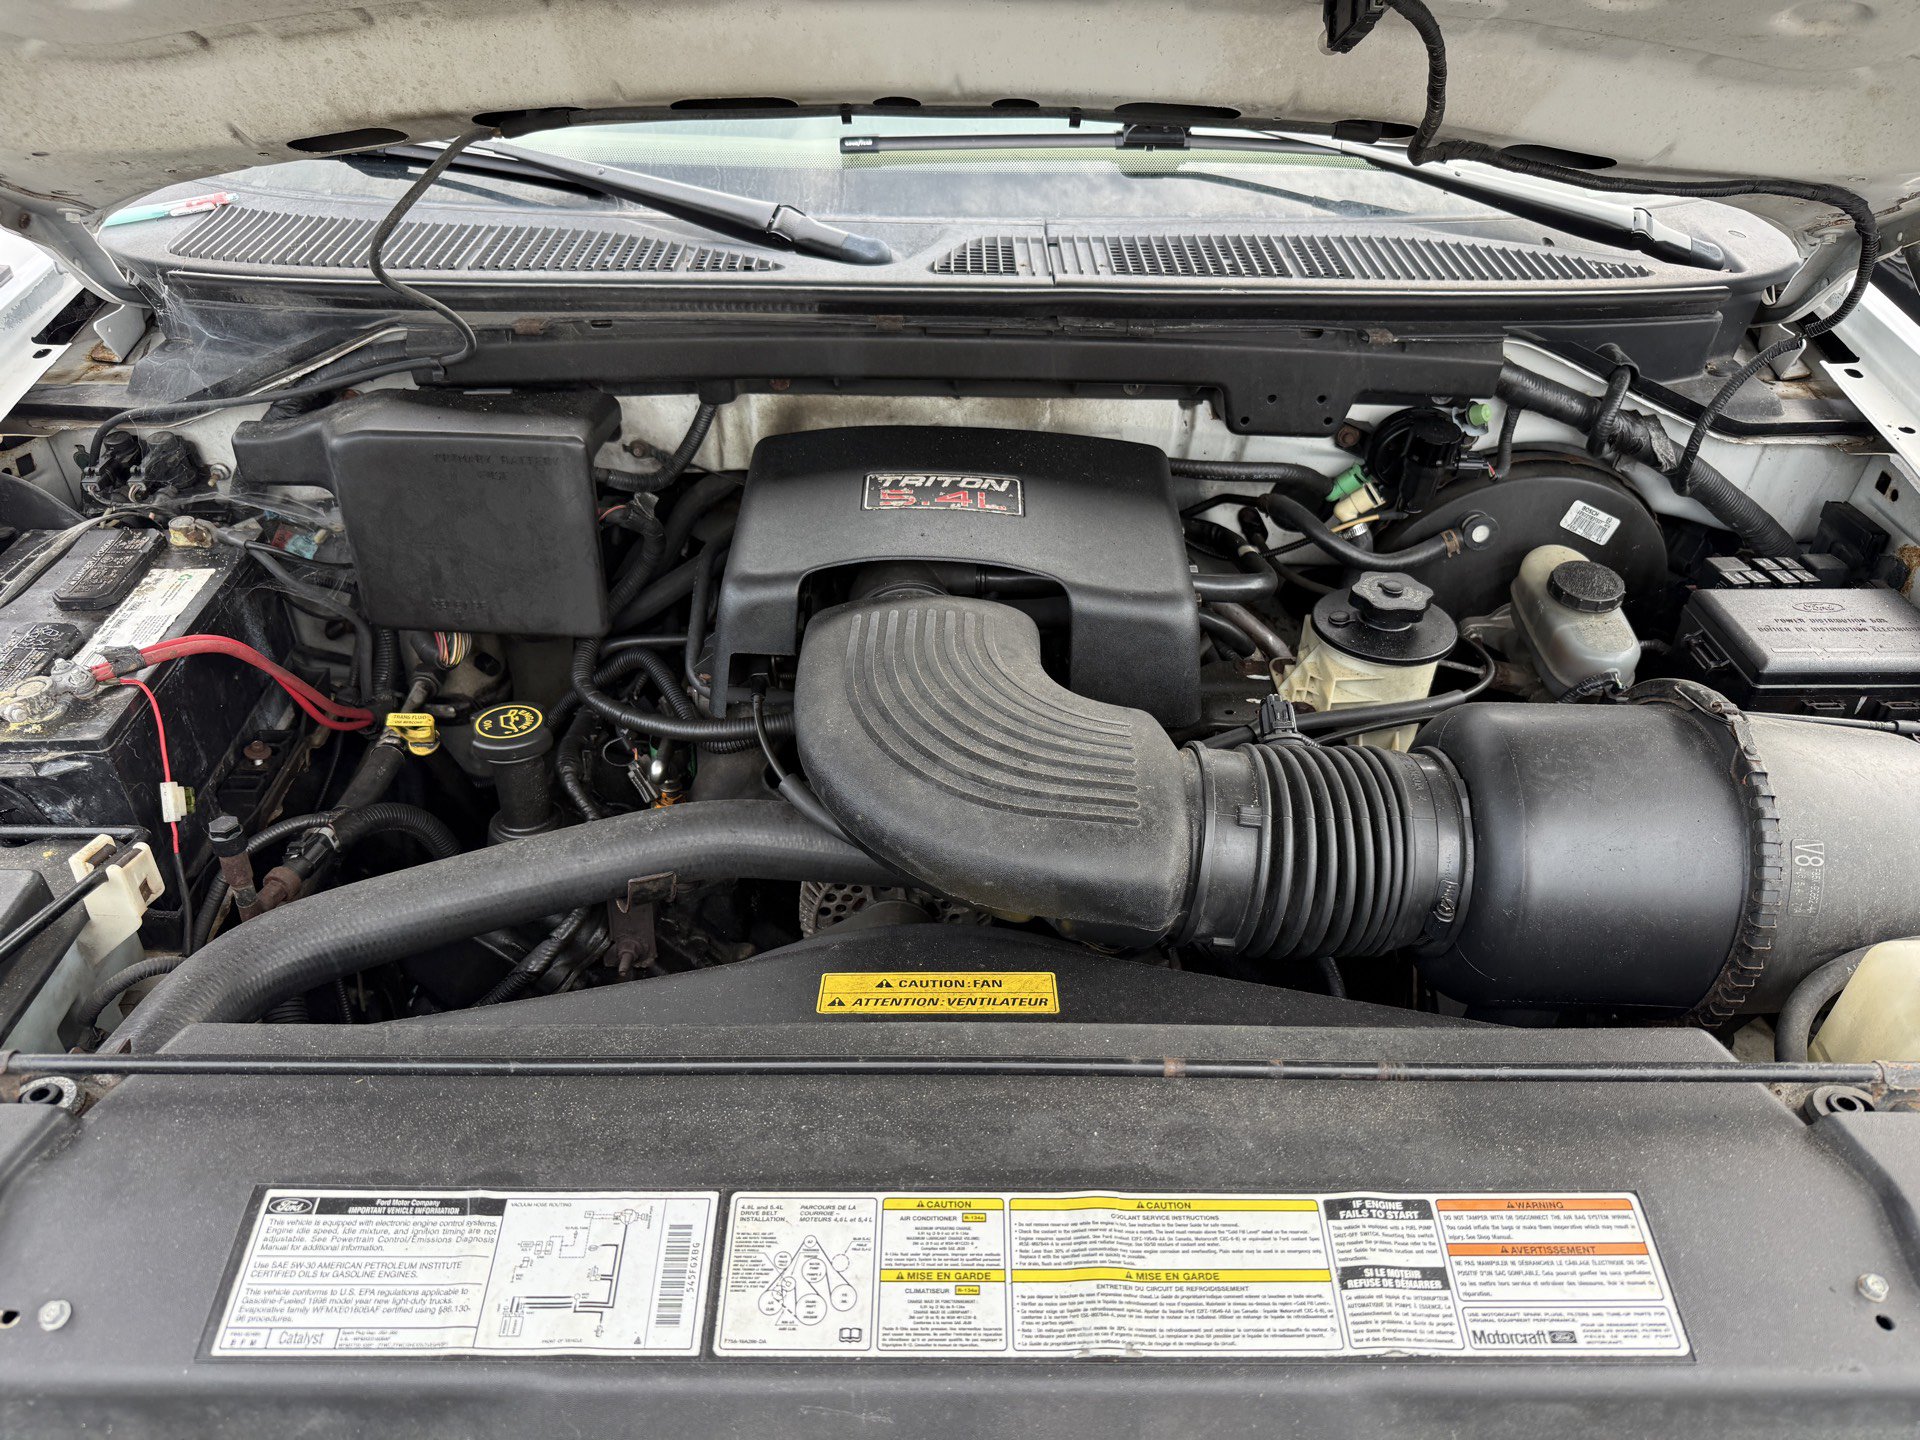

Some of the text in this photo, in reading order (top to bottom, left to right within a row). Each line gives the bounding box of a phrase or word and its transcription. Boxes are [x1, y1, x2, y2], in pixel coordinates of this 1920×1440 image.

[878, 476, 1011, 492] TRITON
[879, 489, 1007, 511] 5.4L
[1581, 505, 1599, 516] BOSCH
[482, 719, 493, 731] OIL
[517, 710, 535, 731] ENGINE
[1794, 843, 1825, 867] V8
[973, 979, 1002, 988] FAN
[947, 997, 1049, 1007] VENTILATEUR
[276, 1199, 304, 1212] Ford
[411, 1199, 441, 1208] Company
[926, 1200, 972, 1208] CAUTION
[1146, 1201, 1192, 1209] CAUTION
[1351, 1200, 1404, 1210] IF ENGINE
[1515, 1201, 1564, 1209] WARNING
[347, 1206, 386, 1214] IMPORTANT
[414, 1207, 460, 1215] INFORMATION
[1339, 1209, 1420, 1219] FAILS TO START
[322, 1219, 357, 1227] equipped
[375, 1219, 412, 1227] electronic
[439, 1219, 465, 1227] control
[465, 1220, 498, 1228] systems.
[265, 1227, 294, 1235] Engine
[359, 1227, 390, 1236] mixture,
[393, 1227, 409, 1235] and
[411, 1227, 440, 1236] ignition
[442, 1228, 466, 1236] timing
[263, 1235, 307, 1243] adjustable.
[377, 1235, 452, 1243] Control/Emissions
[455, 1236, 495, 1244] Diagnosis
[260, 1243, 289, 1251] Manual
[290, 1243, 300, 1251] for
[340, 1244, 385, 1252] information.
[1510, 1245, 1596, 1254] AVERTISSEMENT
[253, 1261, 463, 1270] Use SAE 5W-30 AMERICAN PETROLEUM INSTITUTE
[250, 1270, 418, 1278] CERTIFIED OILS for GASOLINE ENGINES.
[907, 1272, 991, 1280] MISE EN GARDE
[1135, 1272, 1220, 1280] MISE EN GARDE
[1363, 1267, 1422, 1278] SI LE MOTEUR
[1096, 1283, 1133, 1291] ENTRETIEN
[1347, 1279, 1382, 1288] REFUSE
[1381, 1279, 1394, 1288] DE
[339, 1288, 355, 1296] U.S.
[358, 1288, 376, 1296] EPA
[377, 1288, 419, 1297] regulations
[421, 1288, 459, 1297] applicable
[391, 1297, 427, 1306] light-duty
[238, 1306, 285, 1314] Evaporative
[286, 1306, 310, 1314] family
[278, 1330, 325, 1348] Catalyst
[1472, 1330, 1548, 1344] Motorcraft
